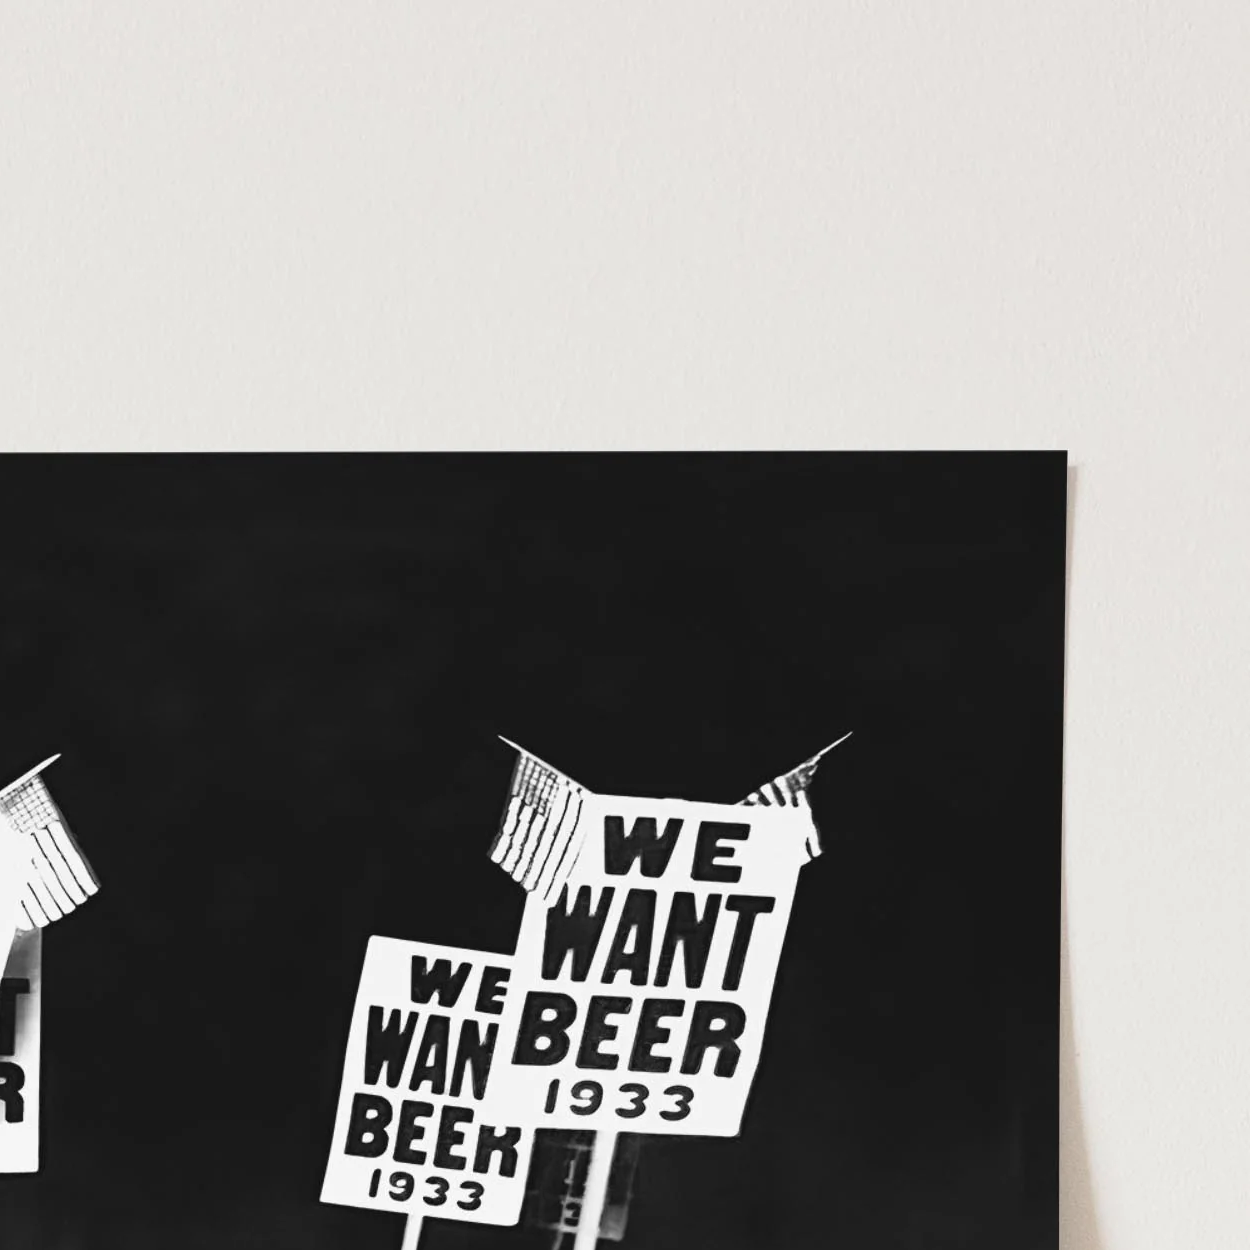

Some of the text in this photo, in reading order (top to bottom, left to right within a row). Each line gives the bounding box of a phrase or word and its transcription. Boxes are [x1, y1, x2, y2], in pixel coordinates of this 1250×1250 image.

[604, 816, 750, 883] WE
[541, 882, 776, 991] WANT
[411, 955, 511, 1015] WE
[364, 1005, 499, 1100] WAN
[511, 991, 746, 1078] BEER
[344, 1093, 521, 1178] BEER
[545, 1079, 694, 1121] 1933
[369, 1169, 484, 1211] 1933
